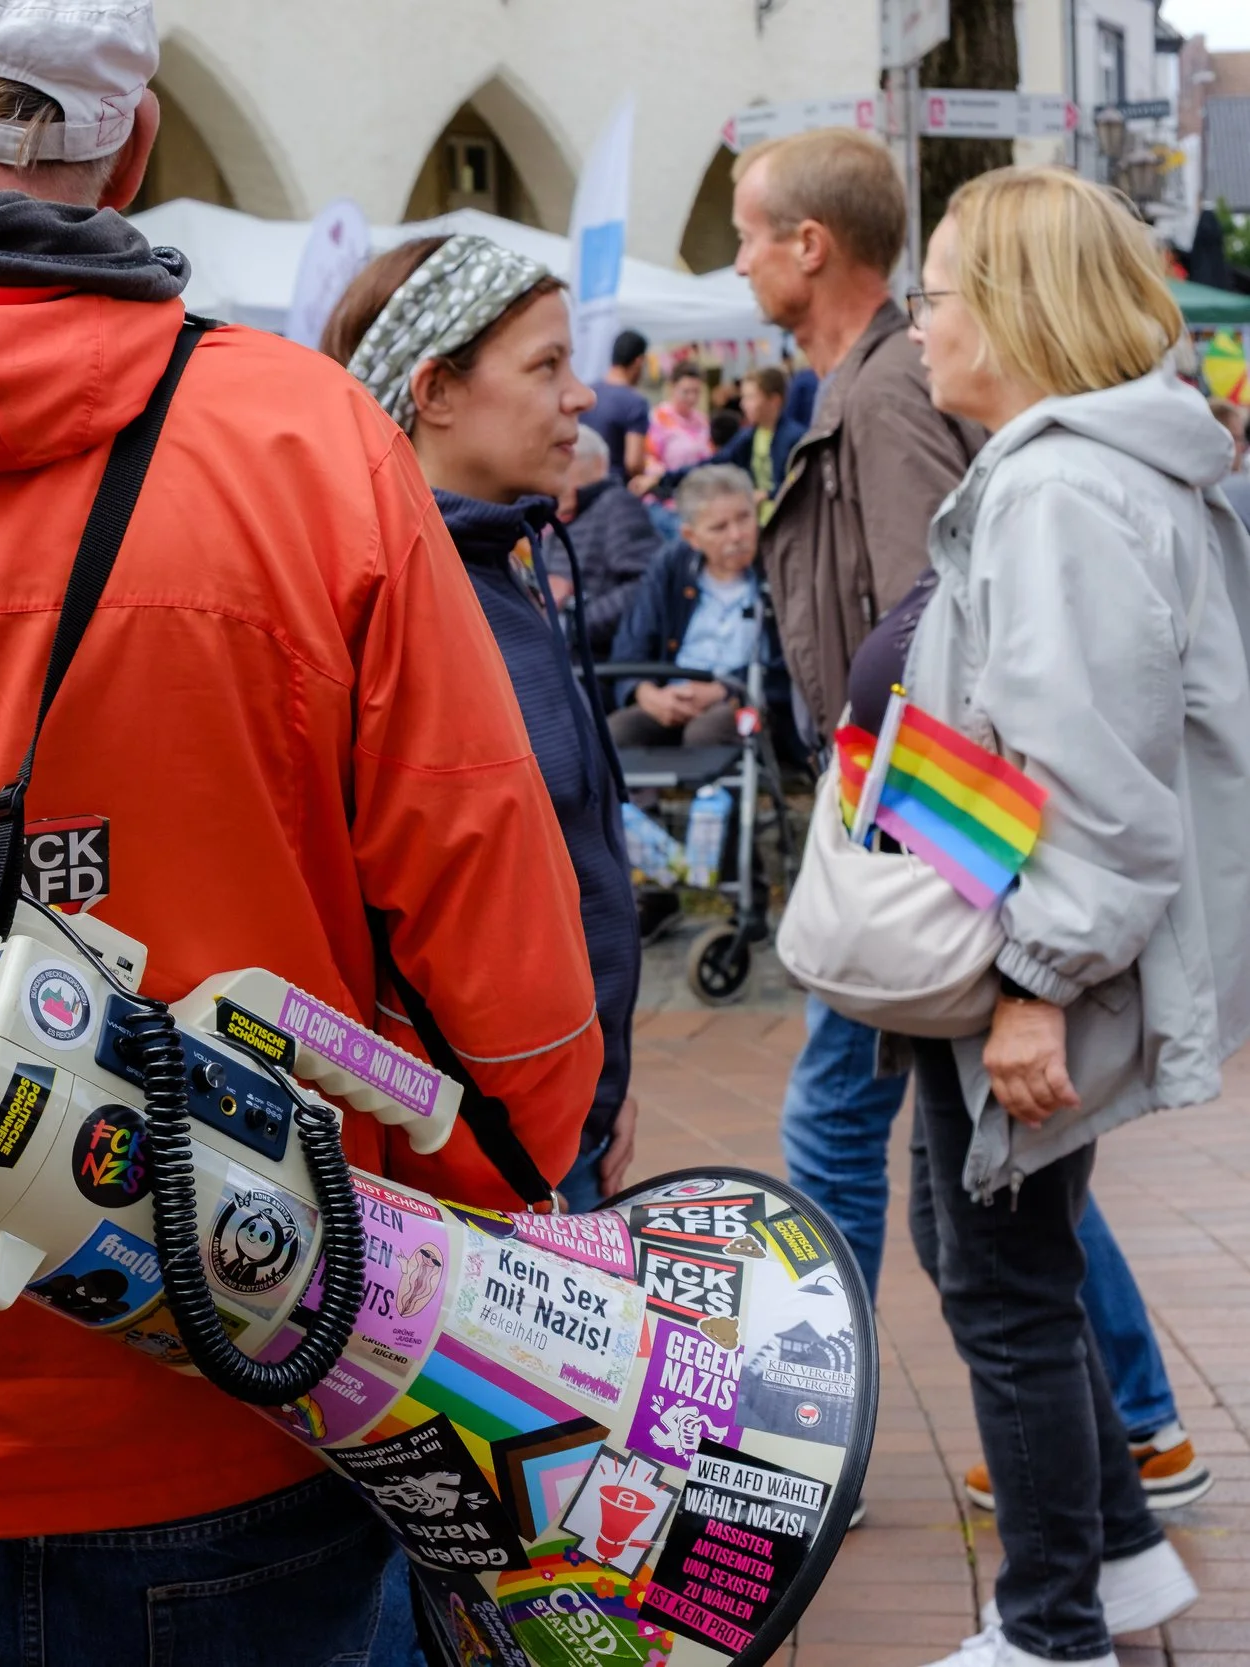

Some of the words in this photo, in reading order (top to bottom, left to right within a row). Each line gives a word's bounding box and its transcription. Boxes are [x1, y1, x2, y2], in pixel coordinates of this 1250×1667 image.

[24, 829, 103, 869] CK
[44, 971, 88, 1006] RECKLINGHAUSEN
[227, 1023, 284, 1060] SCHÖNHEIT
[231, 1011, 287, 1050] POLITISCHE
[284, 998, 306, 1031] NO
[307, 1010, 347, 1055] COPS
[368, 1048, 388, 1082] NO
[389, 1060, 434, 1106] NAZIS
[0, 1083, 41, 1156] POLITISCHE
[90, 1119, 147, 1161] FCK
[81, 1152, 145, 1194] NZS
[255, 1193, 271, 1203] ADHS
[354, 1179, 381, 1198] BIST
[383, 1189, 432, 1217] SCHÖN!
[355, 1194, 404, 1234] TZEN
[648, 1205, 748, 1221] FCK
[515, 1220, 626, 1266] NATIONALISM
[646, 1217, 747, 1238] AFD
[773, 1221, 809, 1262] SCHÖNHEIT
[783, 1219, 820, 1260] POLITISCHE
[274, 1272, 285, 1282] DA
[498, 1249, 550, 1292] Kein
[561, 1276, 608, 1319] Sex
[644, 1271, 733, 1317] NZS
[646, 1254, 737, 1295] FCK
[479, 1304, 548, 1351] #ekelhAfD
[484, 1276, 526, 1316] mit
[533, 1296, 612, 1356] Nazis!
[372, 1347, 408, 1365] JUGEND
[395, 1335, 422, 1345] JUGEND
[665, 1330, 745, 1382] GEGEN
[329, 1364, 364, 1390] lours
[659, 1358, 737, 1411] NAZIS
[764, 1371, 791, 1385] KEIN
[768, 1360, 796, 1373] KEIN
[319, 1376, 368, 1405] autiful
[336, 1442, 402, 1460] anderswo
[410, 1426, 439, 1446] und
[422, 1439, 443, 1454] im
[347, 1450, 422, 1470] Ruhrgebiet
[697, 1459, 730, 1485] WER
[733, 1469, 763, 1492] AFD
[768, 1475, 820, 1508] WÄHLT,
[406, 1521, 491, 1543] Nazis
[684, 1487, 746, 1523] WÄHLT
[746, 1503, 807, 1538] NAZIS!
[418, 1545, 509, 1566] Gegen
[691, 1538, 775, 1582] ANTISEMITEN
[705, 1519, 774, 1561] RASSISTEN,
[682, 1557, 709, 1580] UND
[709, 1567, 771, 1603] SEXISTEN
[549, 1587, 617, 1655] CSD
[650, 1587, 674, 1609] IST
[672, 1600, 708, 1627] KEIN
[682, 1581, 702, 1600] ZU
[701, 1587, 754, 1621] WÄHLEN
[482, 1601, 515, 1646] Queer
[533, 1598, 580, 1649] STATT
[574, 1645, 604, 1667] AF
